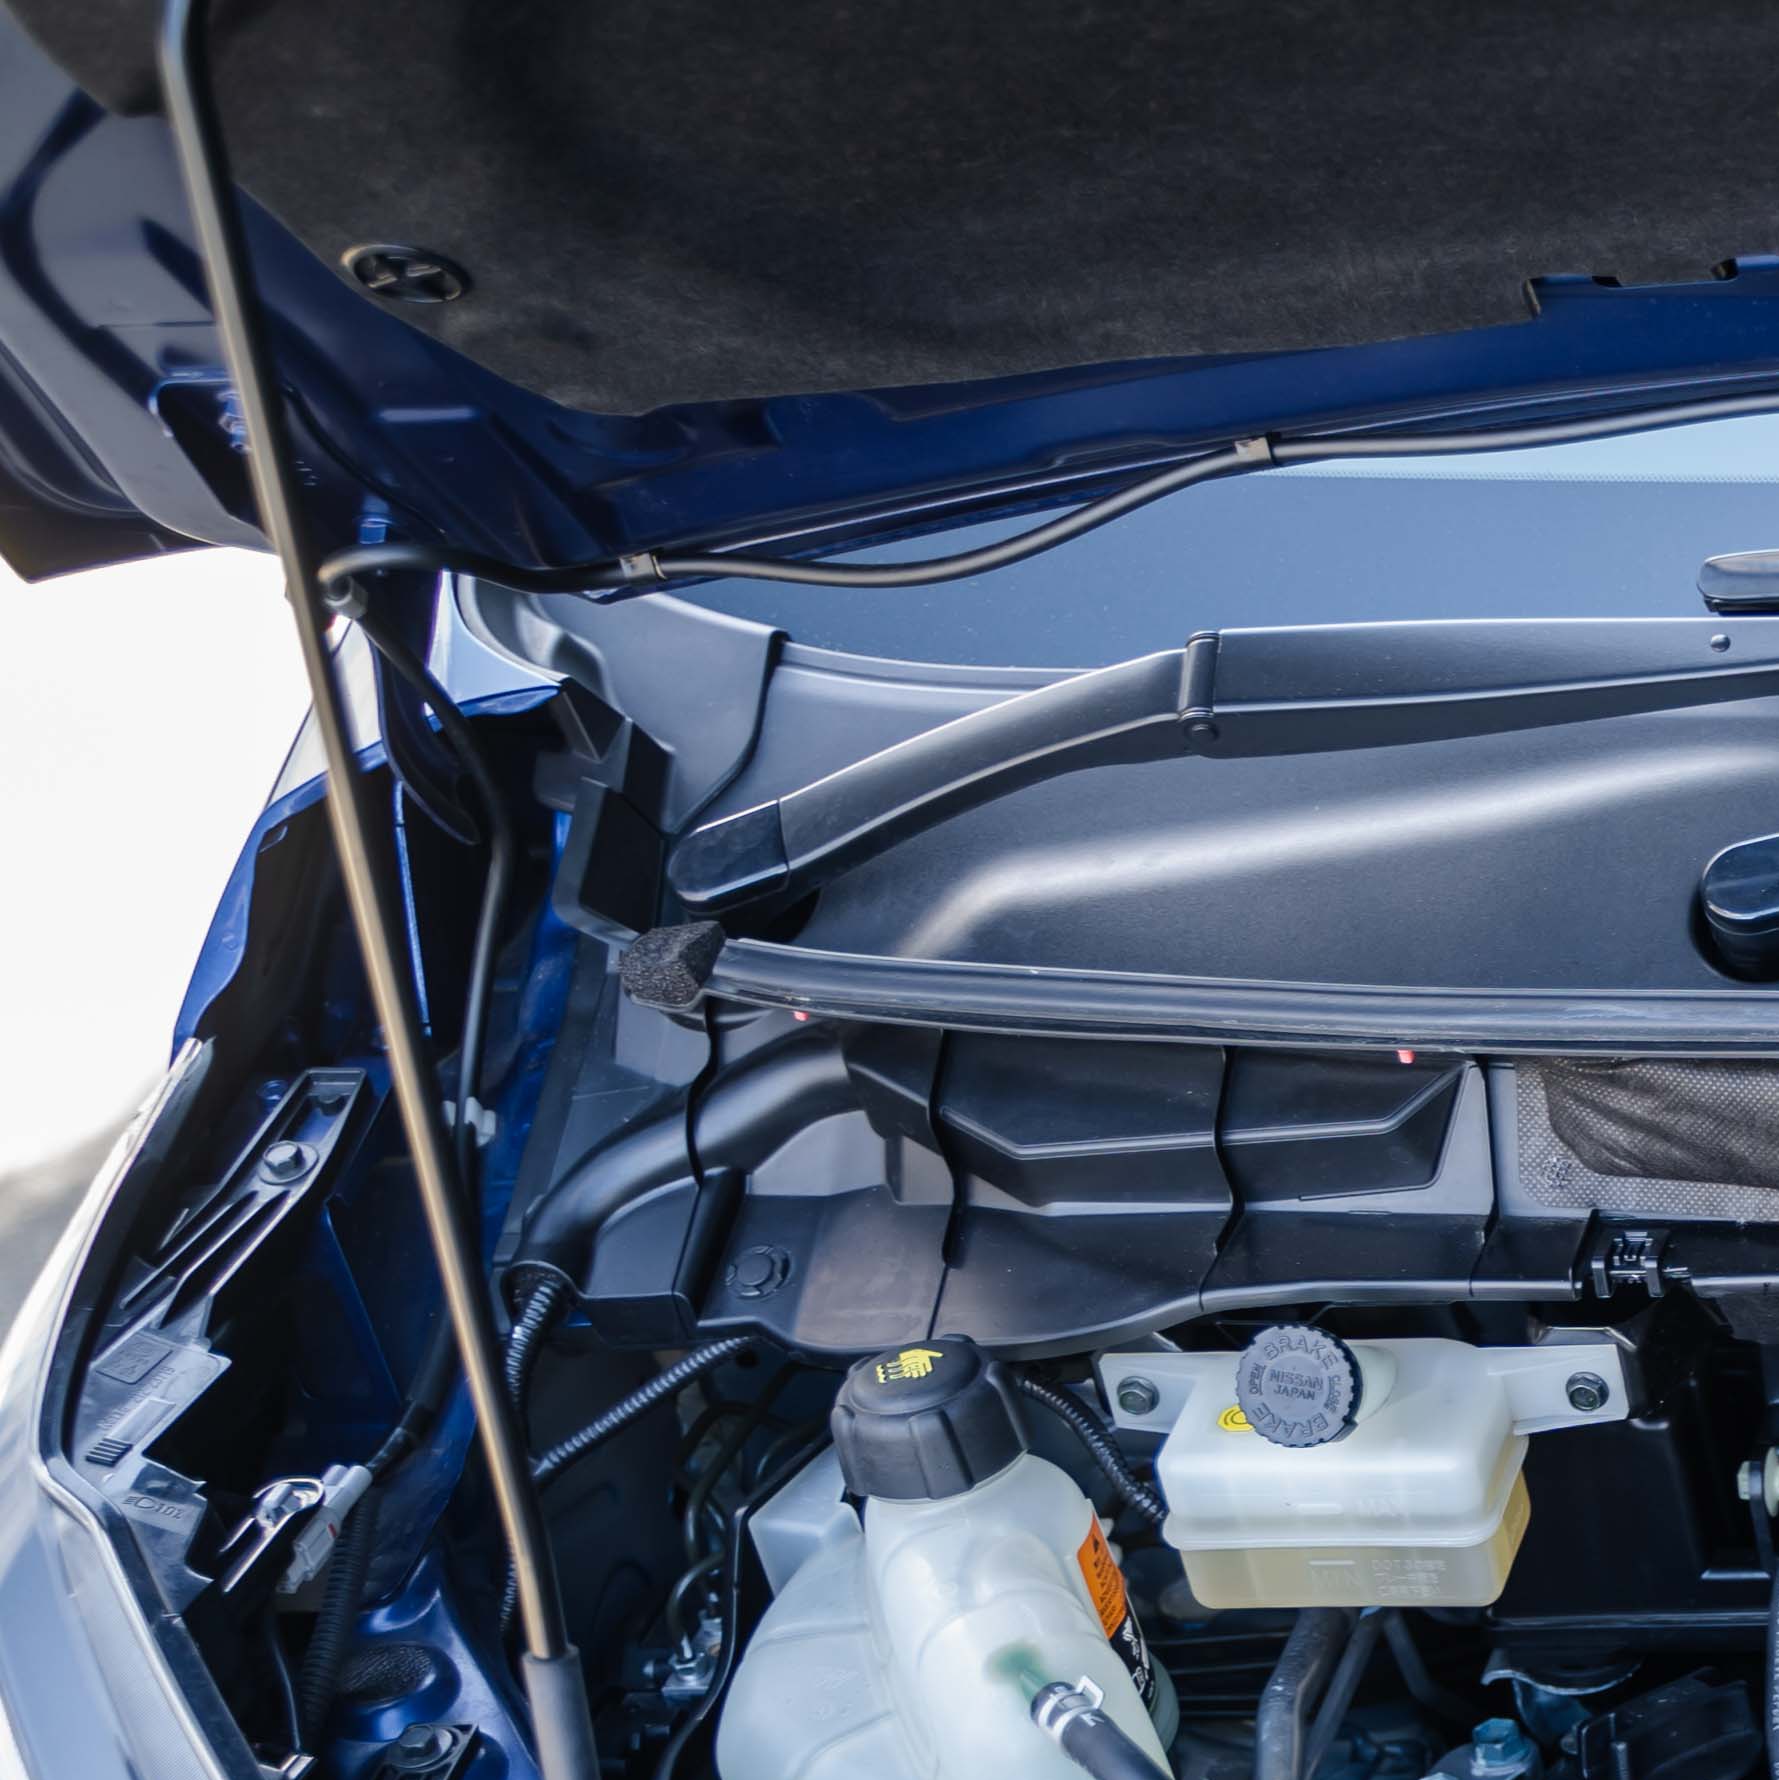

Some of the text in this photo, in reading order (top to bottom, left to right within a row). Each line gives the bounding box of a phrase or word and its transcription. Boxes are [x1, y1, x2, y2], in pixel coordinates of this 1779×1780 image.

[1264, 1335, 1339, 1370] BRAKE
[1269, 1368, 1323, 1391] NISSAN
[1273, 1385, 1316, 1401] JAPAN
